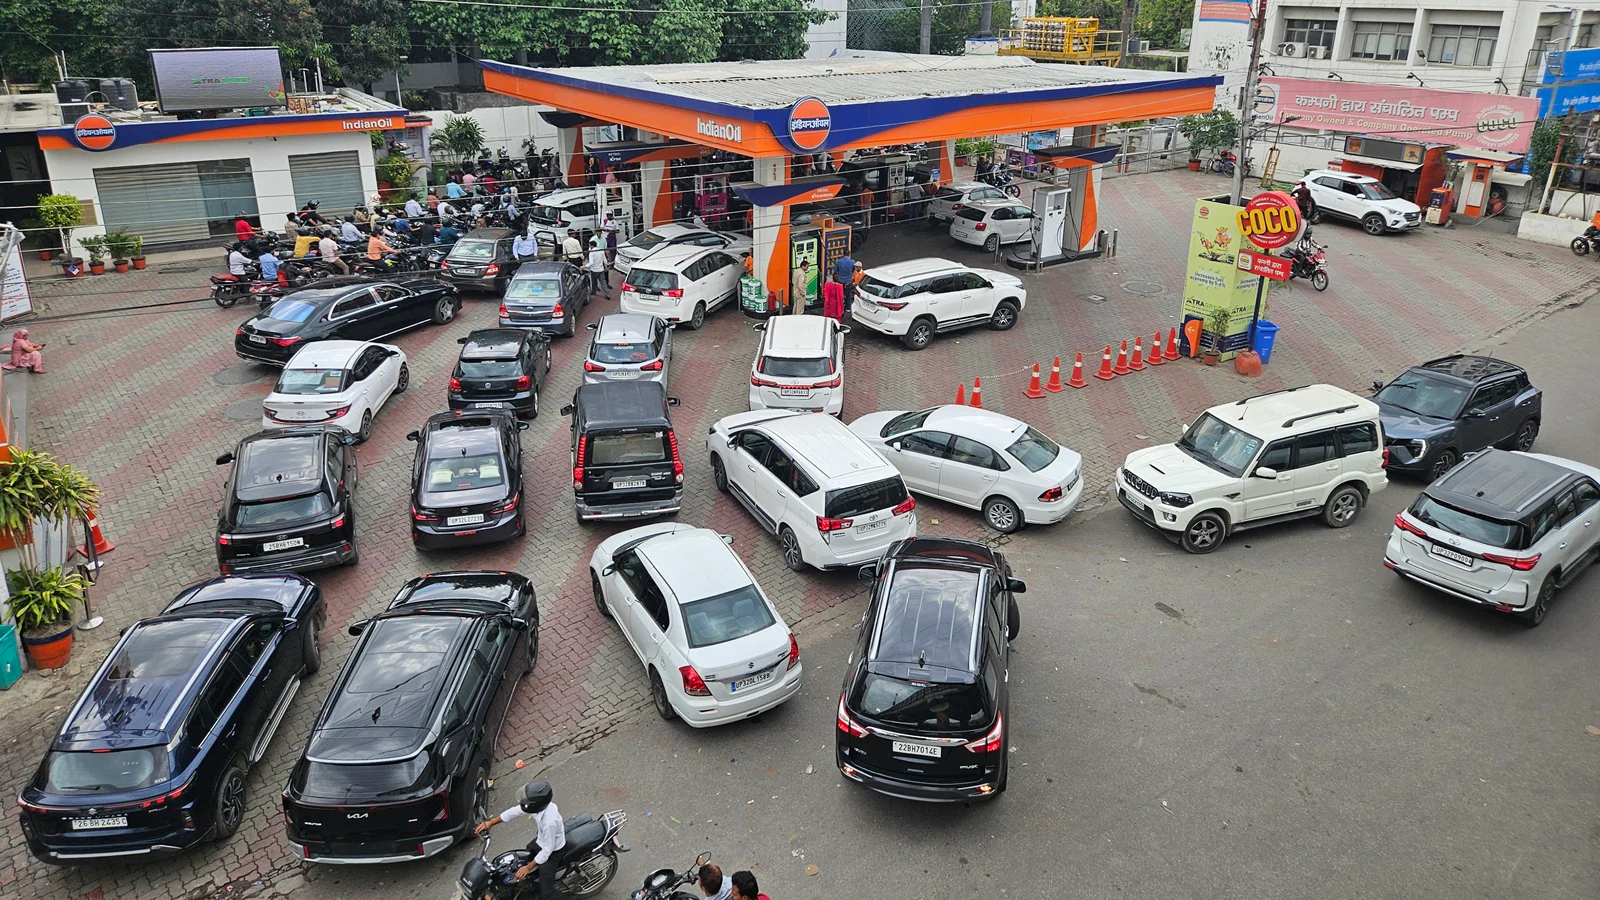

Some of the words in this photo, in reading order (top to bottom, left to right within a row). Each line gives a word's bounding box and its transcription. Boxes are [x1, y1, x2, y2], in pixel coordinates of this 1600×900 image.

[1341, 99, 1367, 113] द्वारा
[1369, 99, 1427, 118] संचालित
[342, 118, 393, 130] IndianOil
[696, 117, 742, 143] IndianOil
[791, 117, 830, 131] इंडियनऑयल
[1317, 115, 1345, 125] Owned
[1347, 116, 1355, 126] &
[1357, 118, 1398, 131] Company
[1400, 123, 1443, 136] Operated
[1445, 128, 1473, 140] Pump
[1477, 116, 1517, 133] COCO
[1236, 206, 1298, 237] COCO
[1190, 275, 1209, 285] economy
[1194, 271, 1215, 281] Increases
[898, 743, 938, 756] 22BH7014E
